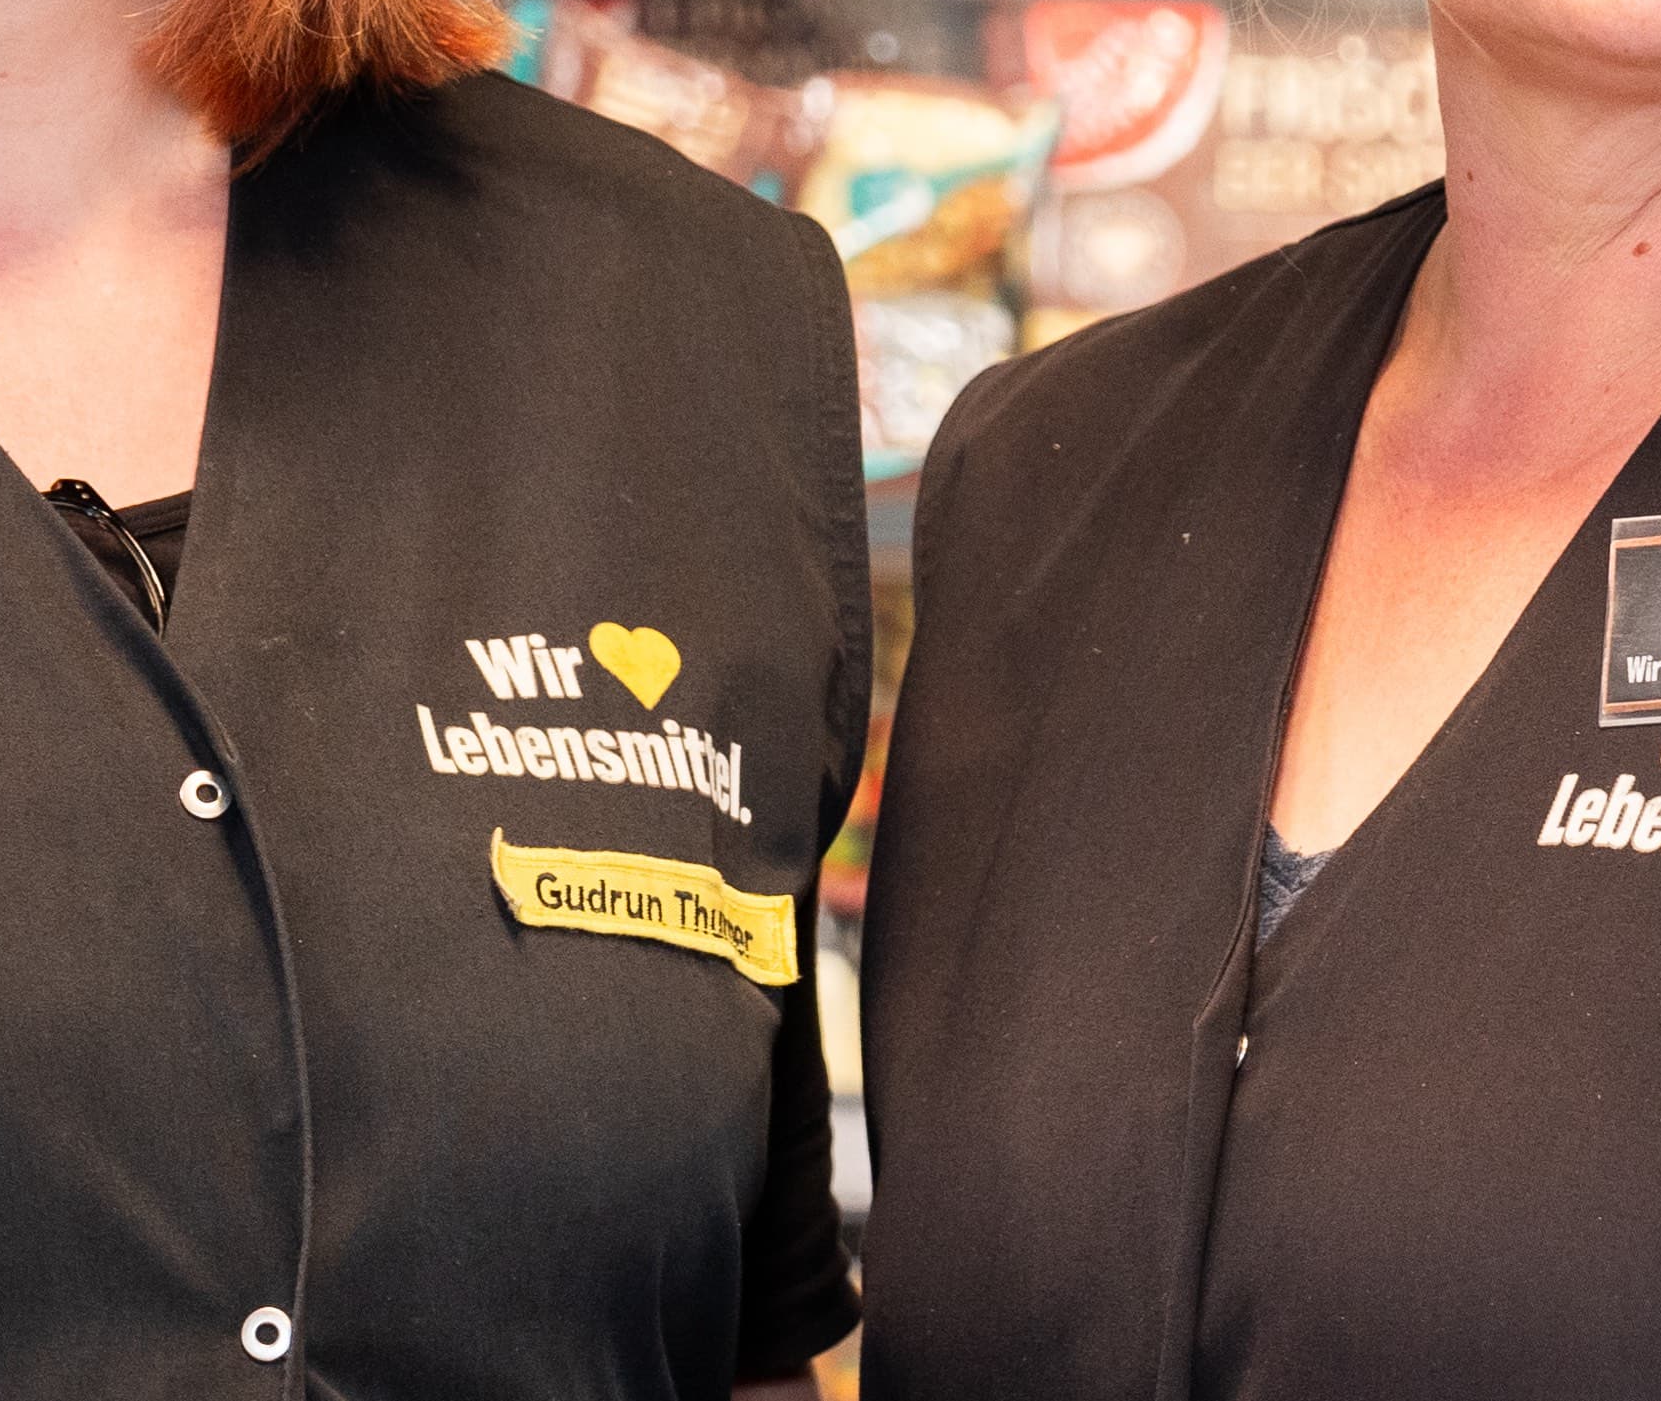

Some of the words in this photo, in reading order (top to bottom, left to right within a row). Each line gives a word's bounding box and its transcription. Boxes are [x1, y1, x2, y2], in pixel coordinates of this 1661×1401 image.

[465, 633, 583, 700] Wir
[416, 703, 752, 825] Lebensmittel.
[535, 872, 665, 922] Gudrun
